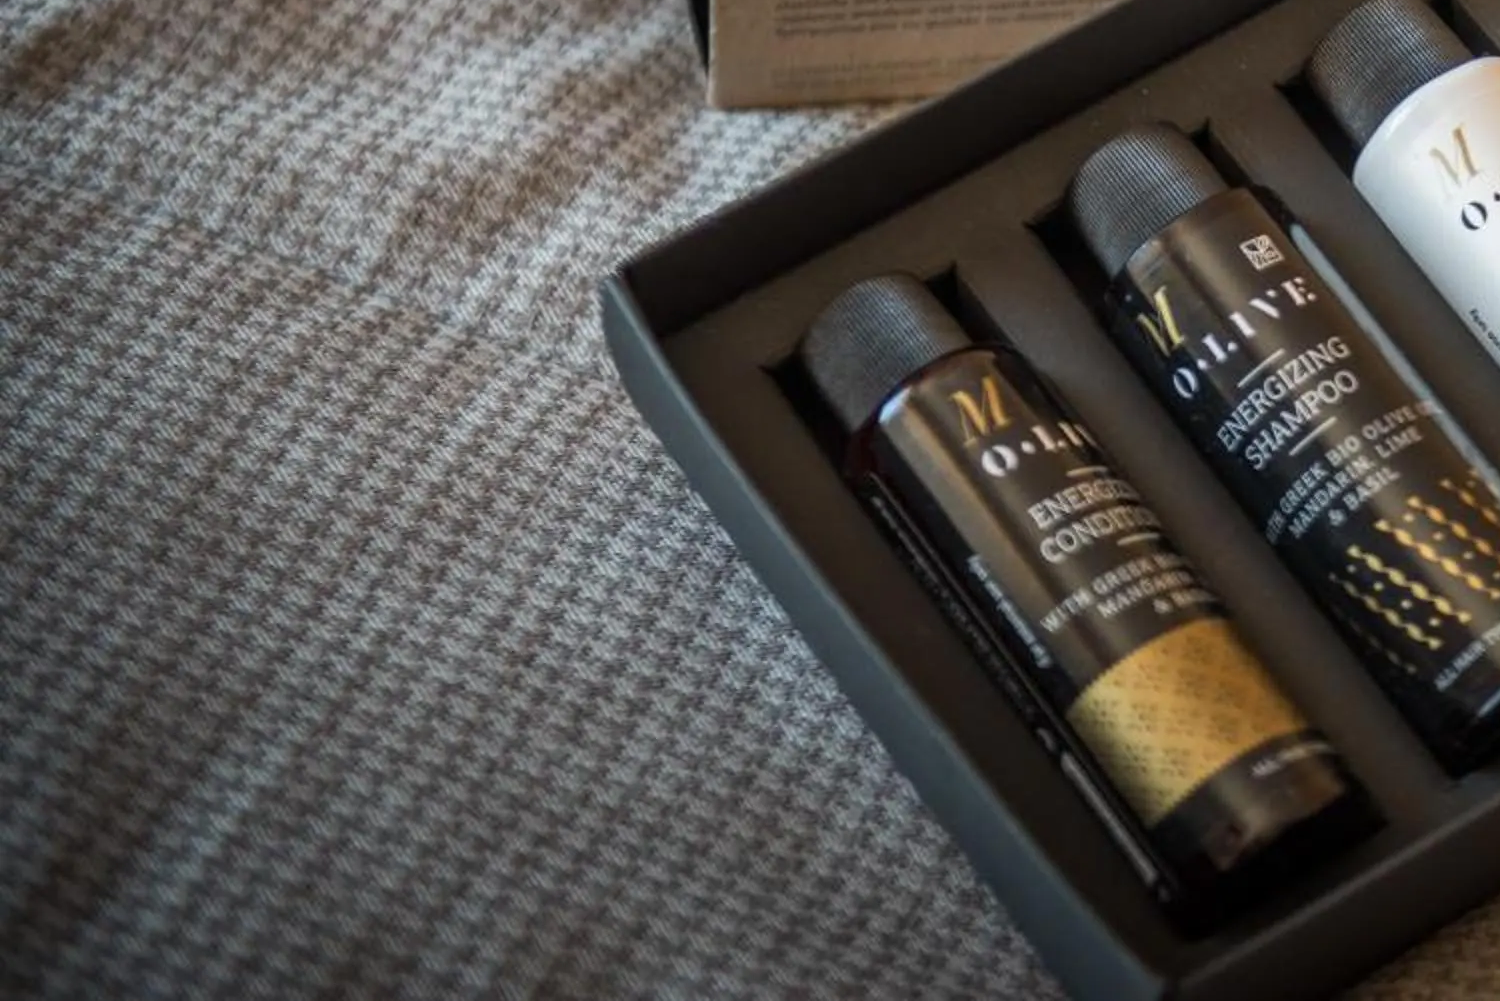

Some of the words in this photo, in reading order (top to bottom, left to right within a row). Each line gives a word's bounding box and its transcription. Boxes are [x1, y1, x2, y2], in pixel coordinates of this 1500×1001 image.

[1216, 335, 1352, 452] ENERGIZING
[1244, 369, 1360, 472] SHAMPOO
[1374, 425, 1424, 459] LIME
[1279, 461, 1329, 515] GREEK
[1324, 435, 1361, 468] BIO
[1361, 405, 1418, 441] OLIVE
[1342, 466, 1403, 512] BASIL
